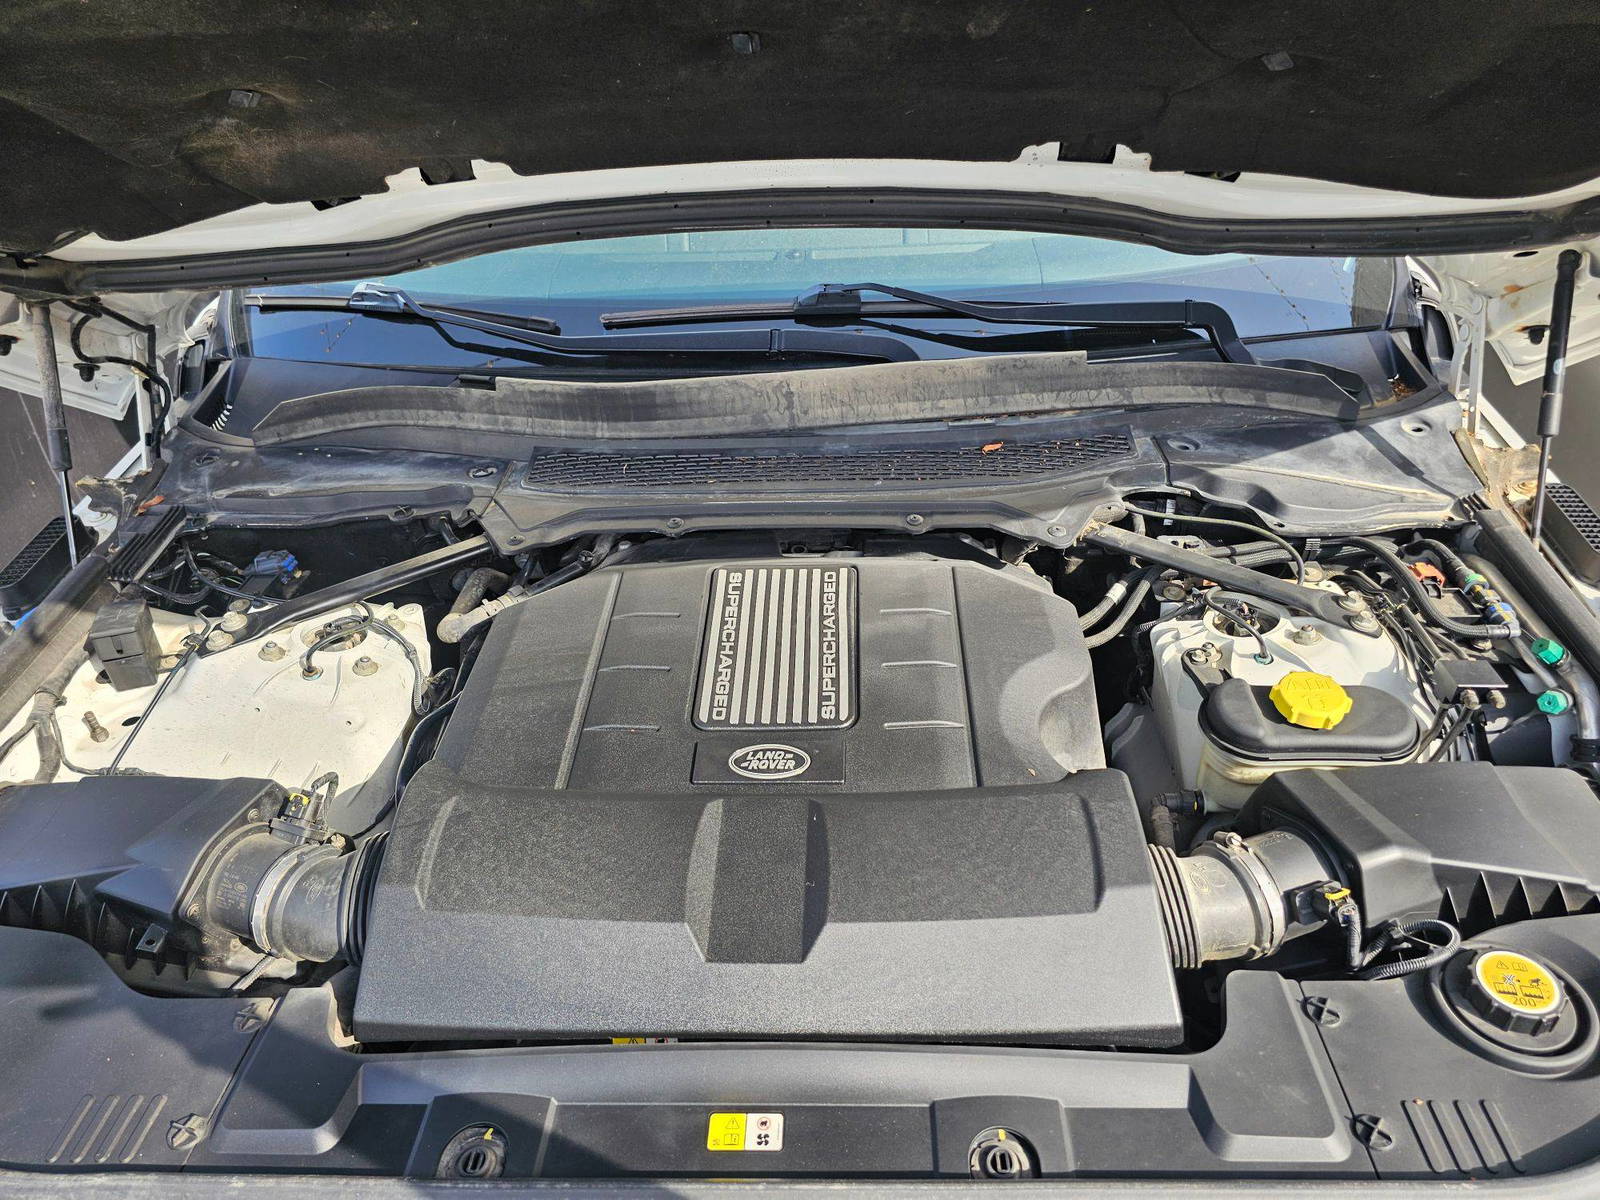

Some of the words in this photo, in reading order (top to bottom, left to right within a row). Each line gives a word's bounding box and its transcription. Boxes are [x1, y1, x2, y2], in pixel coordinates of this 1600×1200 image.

[712, 572, 742, 721] SUPERCHARGED
[821, 571, 837, 719] SUPERCHARGED
[746, 751, 784, 760] LAND
[748, 759, 796, 769] ROVER
